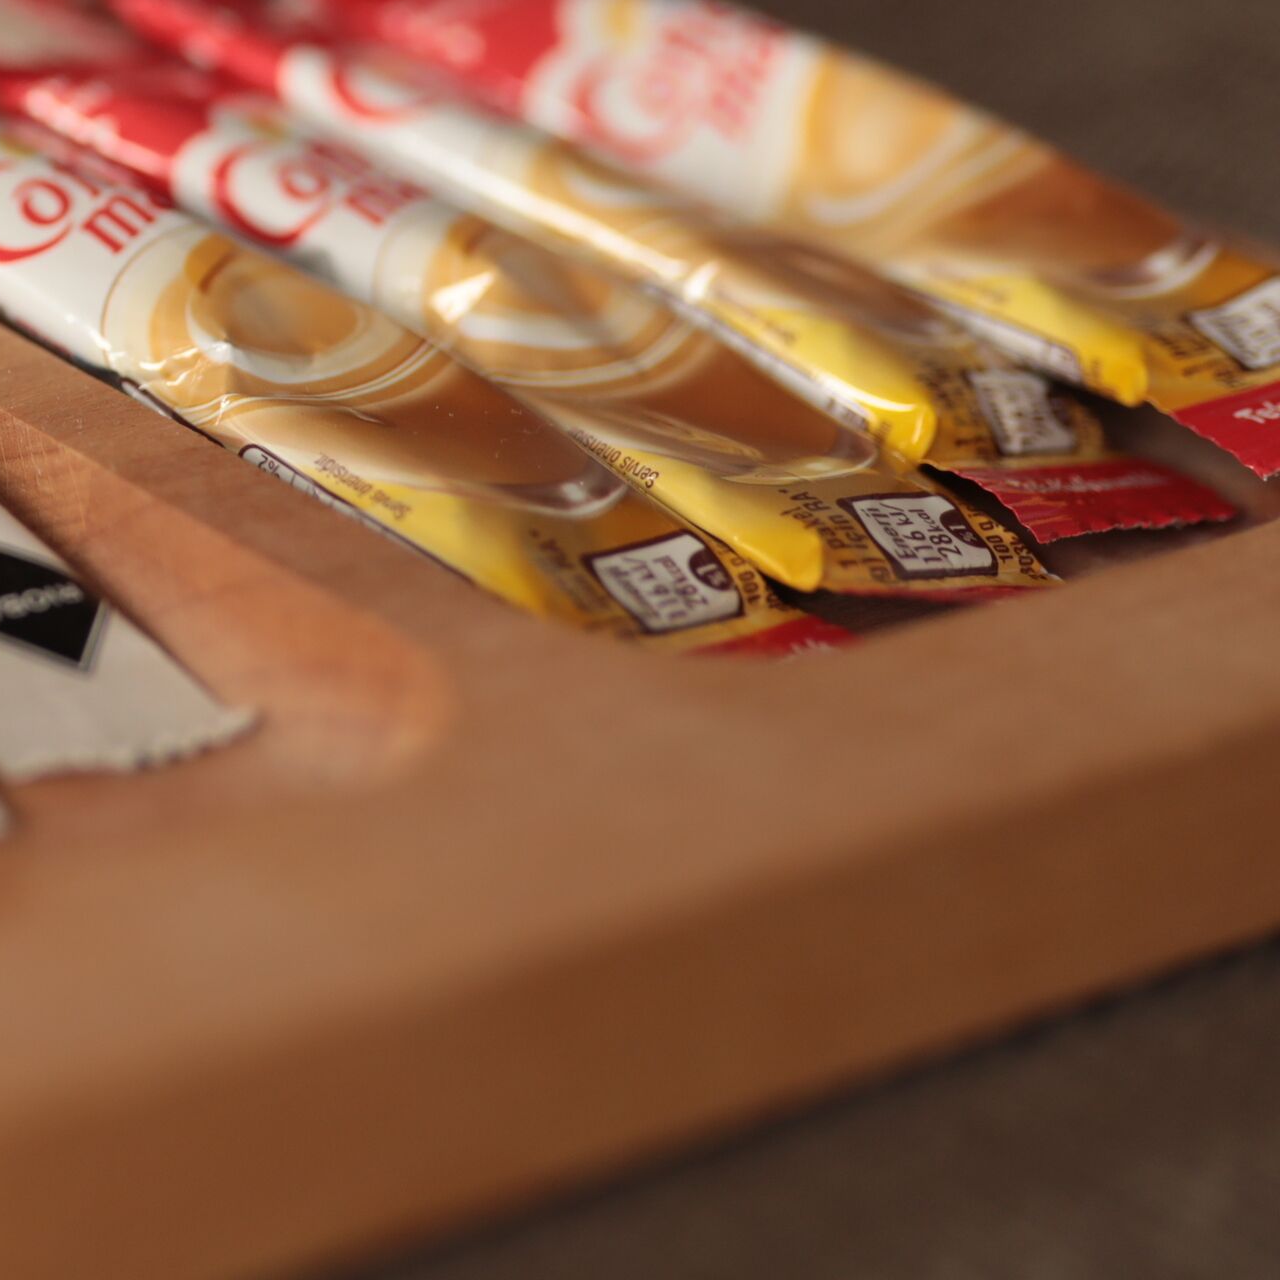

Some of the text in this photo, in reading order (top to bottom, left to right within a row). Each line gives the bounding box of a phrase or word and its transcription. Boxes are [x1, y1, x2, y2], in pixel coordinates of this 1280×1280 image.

[623, 455, 661, 490] Servis
[860, 506, 916, 561] Enerji
[881, 503, 945, 565] 116 kJ/
[986, 534, 1015, 564] 100
